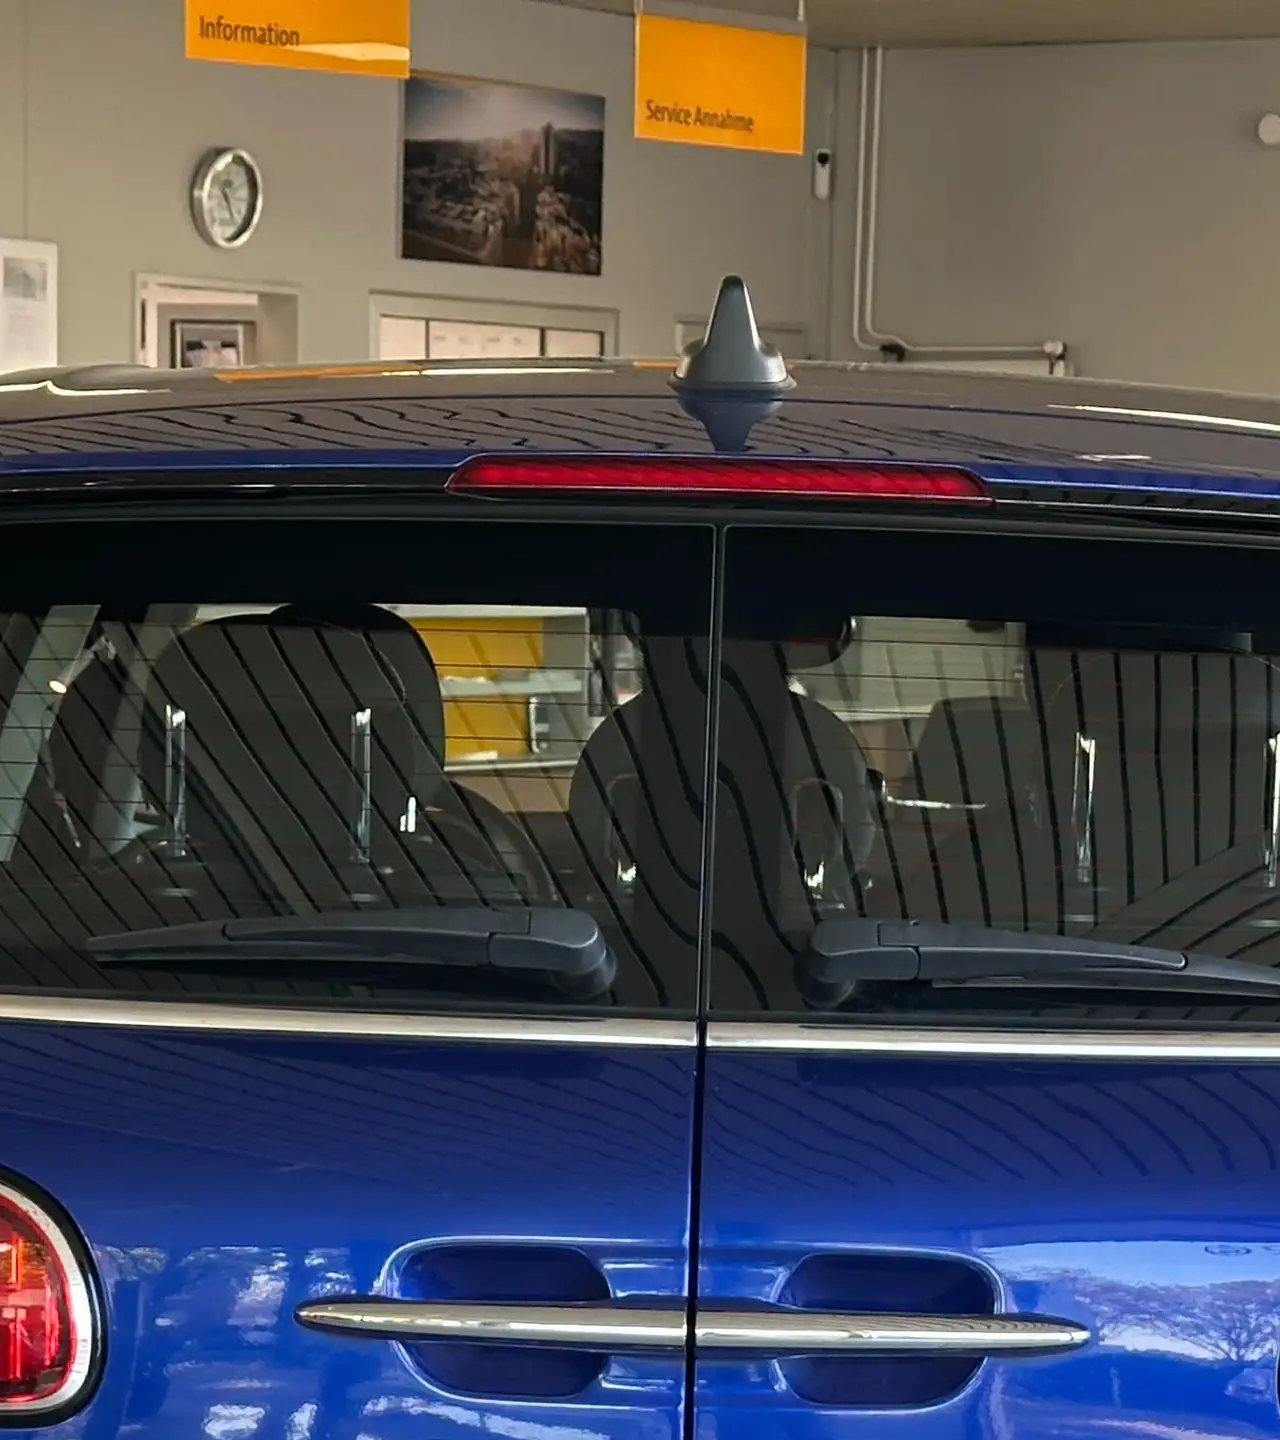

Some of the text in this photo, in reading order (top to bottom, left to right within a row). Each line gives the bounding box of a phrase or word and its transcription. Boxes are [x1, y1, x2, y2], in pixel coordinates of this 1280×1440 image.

[199, 15, 300, 46] Information
[646, 99, 754, 133] Service Annahme
